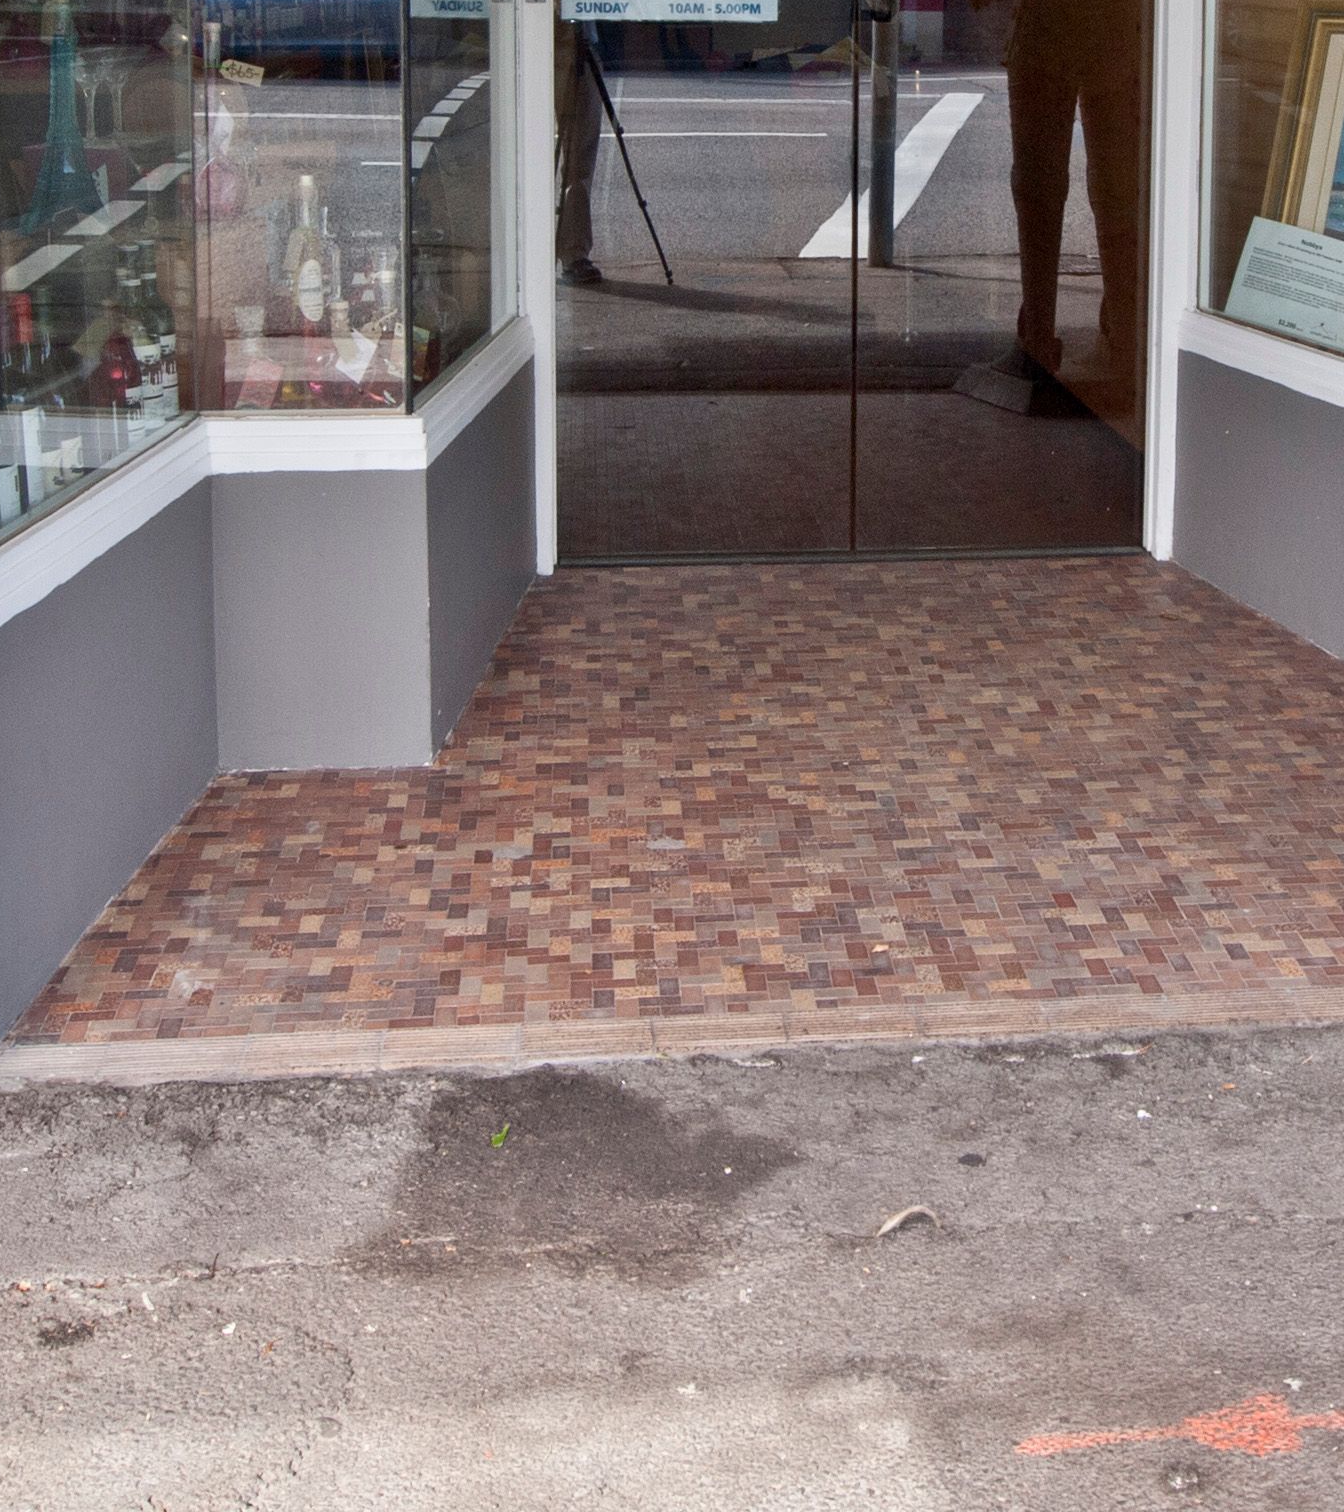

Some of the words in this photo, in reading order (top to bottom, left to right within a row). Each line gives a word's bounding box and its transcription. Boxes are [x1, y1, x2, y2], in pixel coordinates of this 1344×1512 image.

[575, 2, 629, 14] SUNDAY
[668, 3, 705, 14] 10AM
[714, 3, 761, 15] 5.00PM
